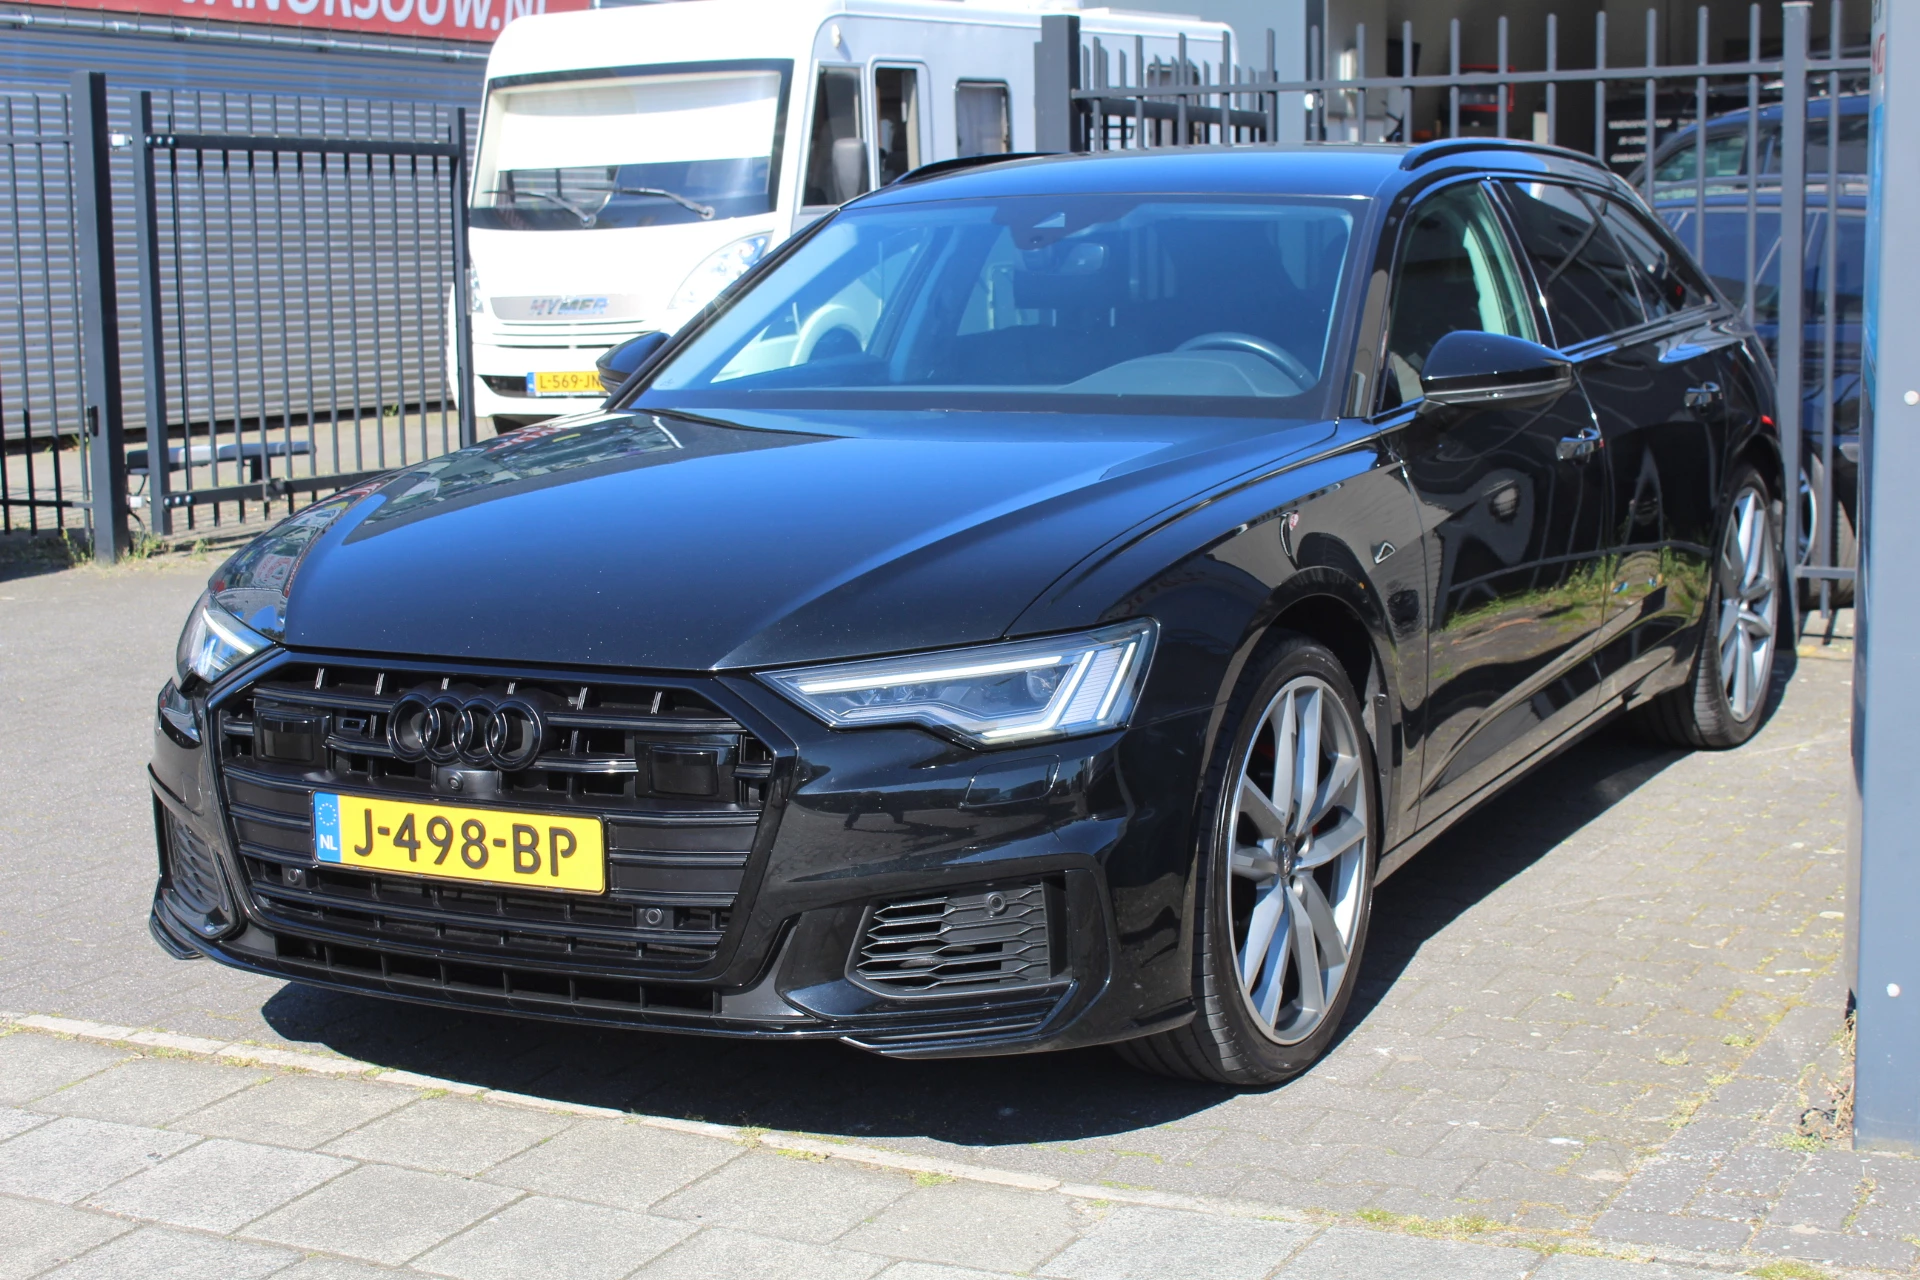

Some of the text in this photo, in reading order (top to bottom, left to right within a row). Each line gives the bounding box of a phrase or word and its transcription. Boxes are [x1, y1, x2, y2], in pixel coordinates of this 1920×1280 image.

[529, 297, 609, 316] HYMER
[319, 833, 338, 851] NL
[354, 808, 577, 877] J-498-BP
